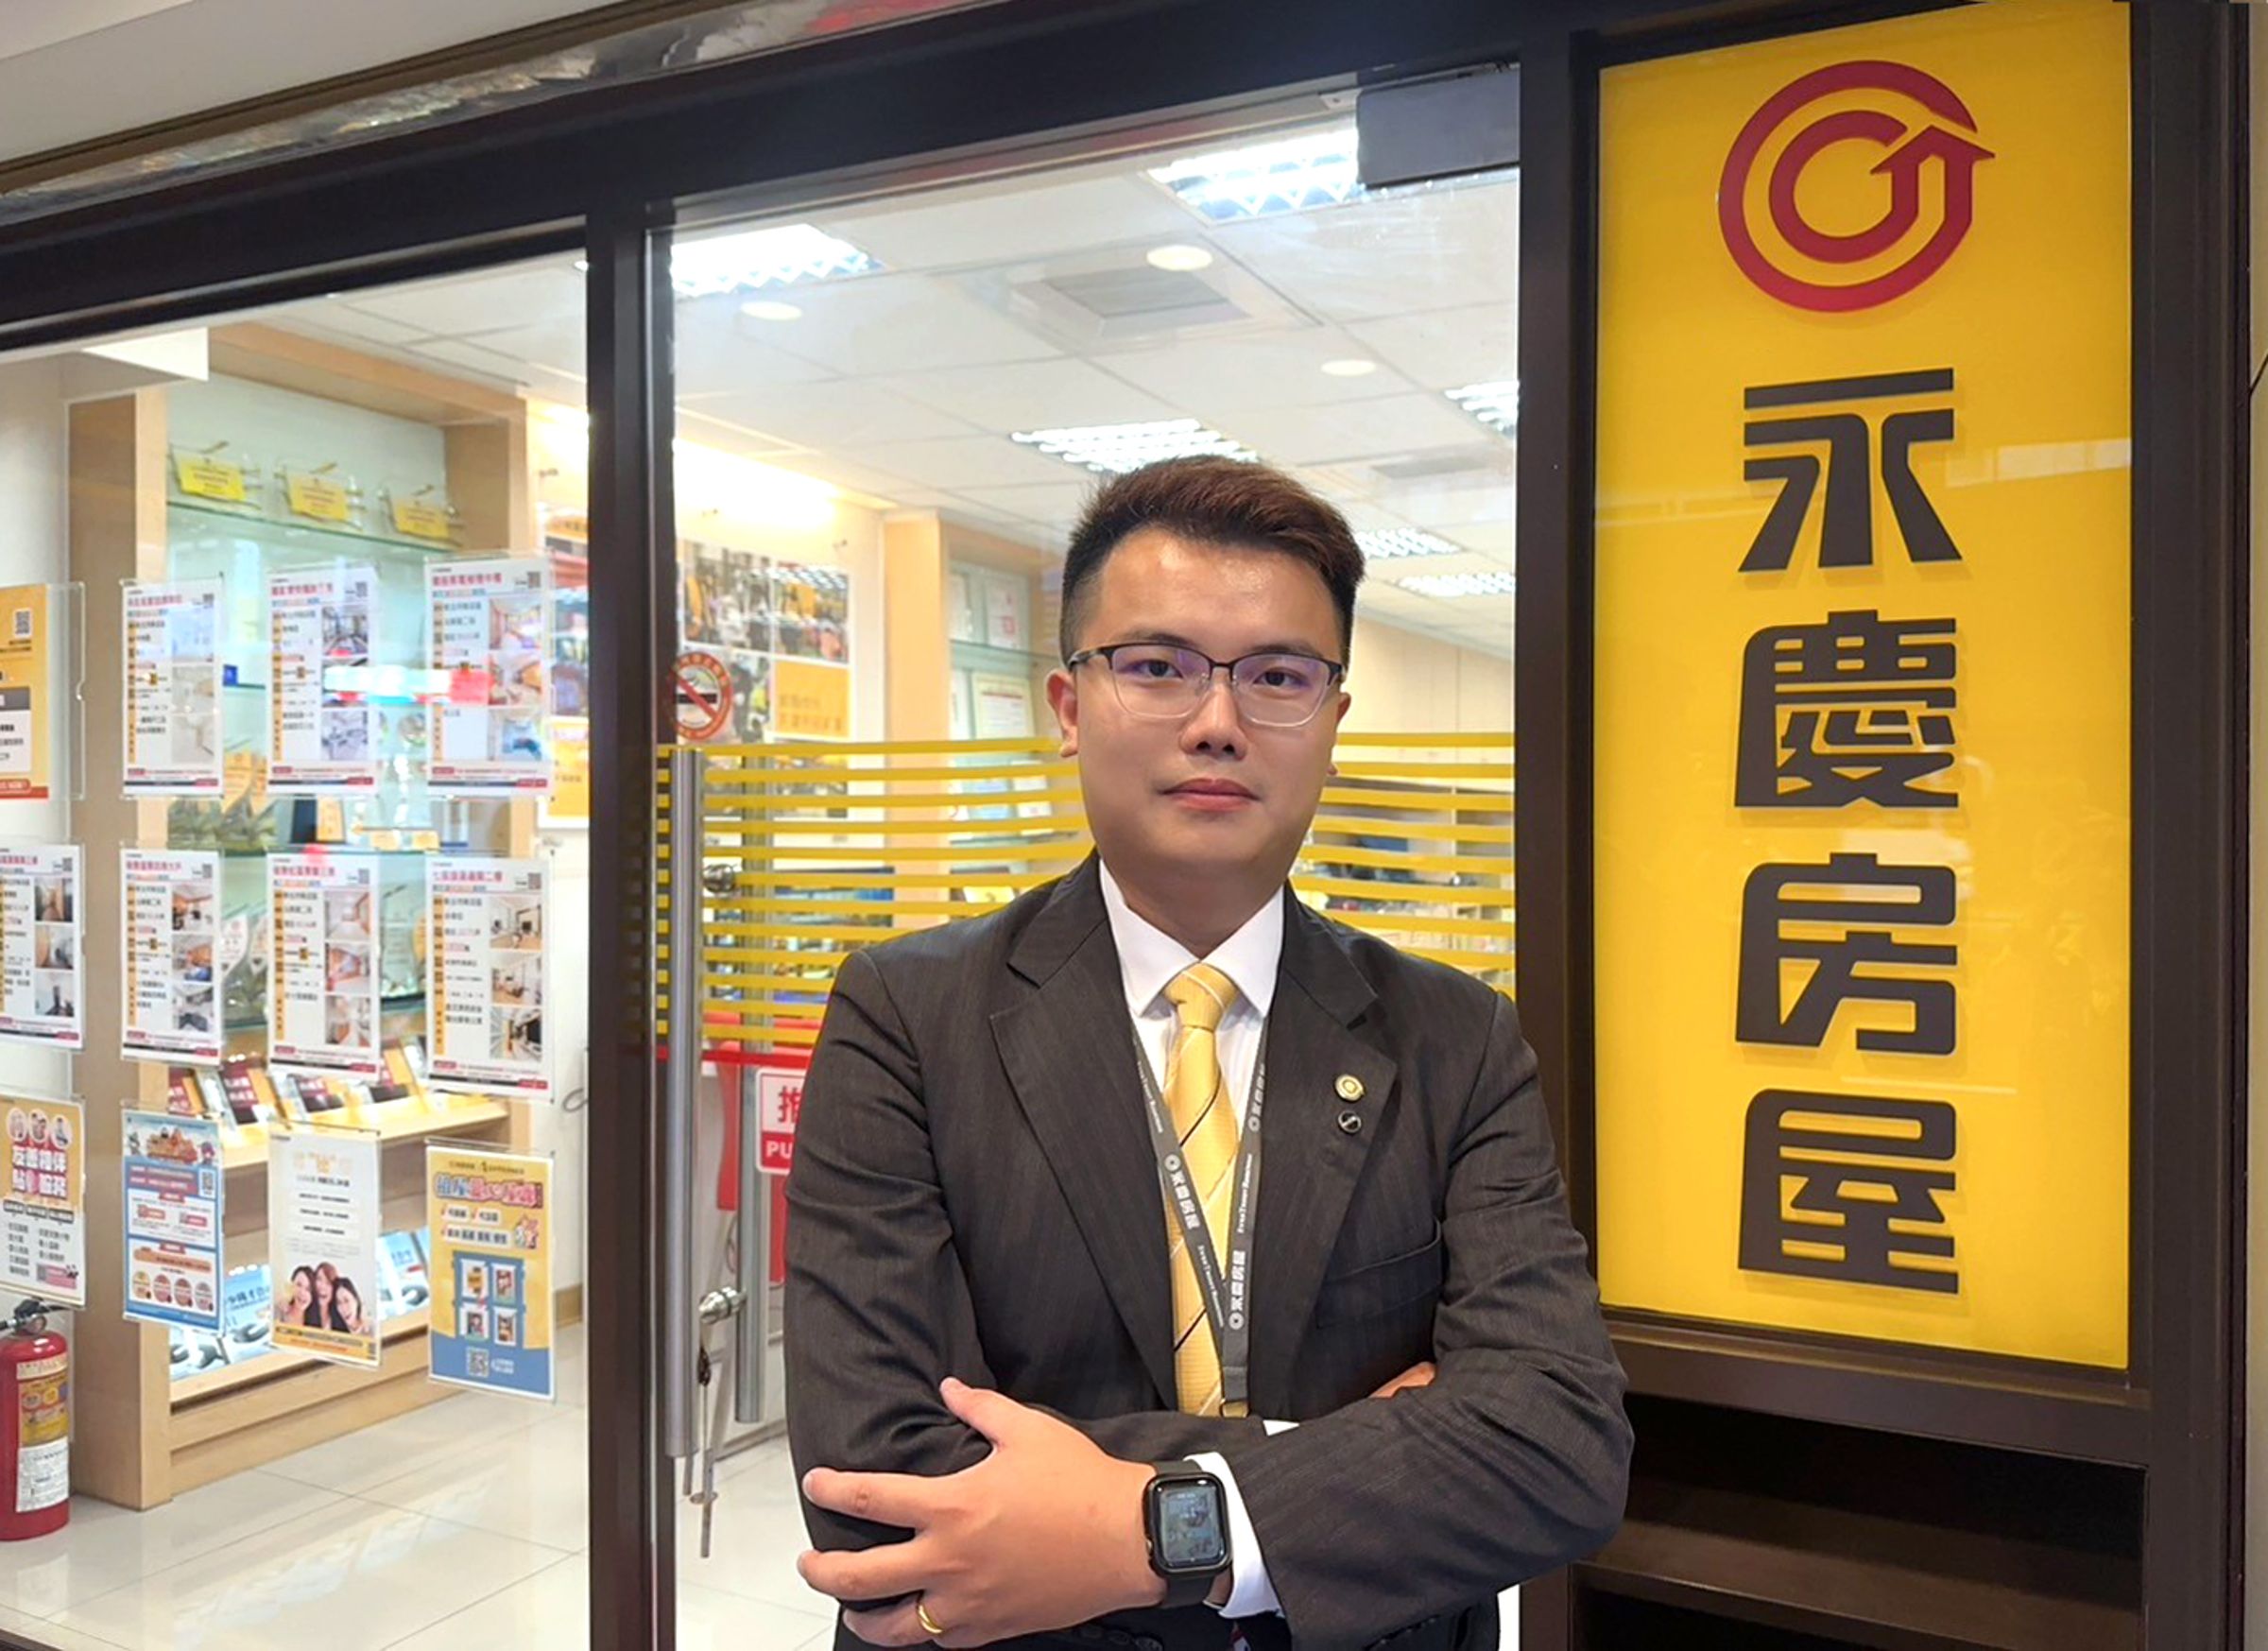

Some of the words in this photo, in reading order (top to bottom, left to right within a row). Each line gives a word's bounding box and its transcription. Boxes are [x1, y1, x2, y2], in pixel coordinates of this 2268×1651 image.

[1735, 367, 1962, 1295] 永慶房屋
[765, 1140, 794, 1159] PU
